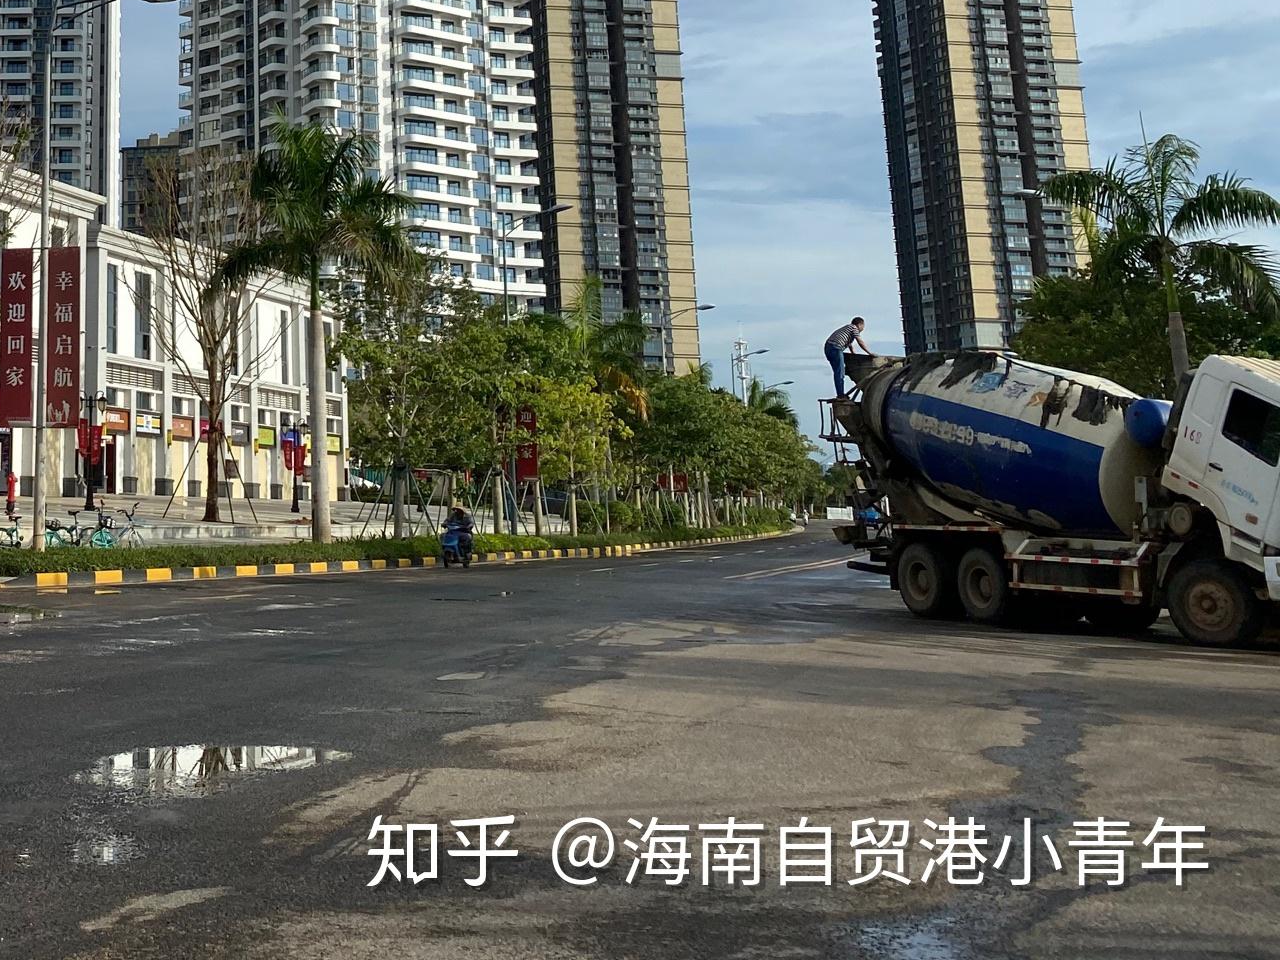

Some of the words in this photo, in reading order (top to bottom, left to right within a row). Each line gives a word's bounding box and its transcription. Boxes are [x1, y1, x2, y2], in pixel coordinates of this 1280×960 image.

[6, 271, 27, 386] 欢迎回家
[53, 271, 73, 387] 幸福启航
